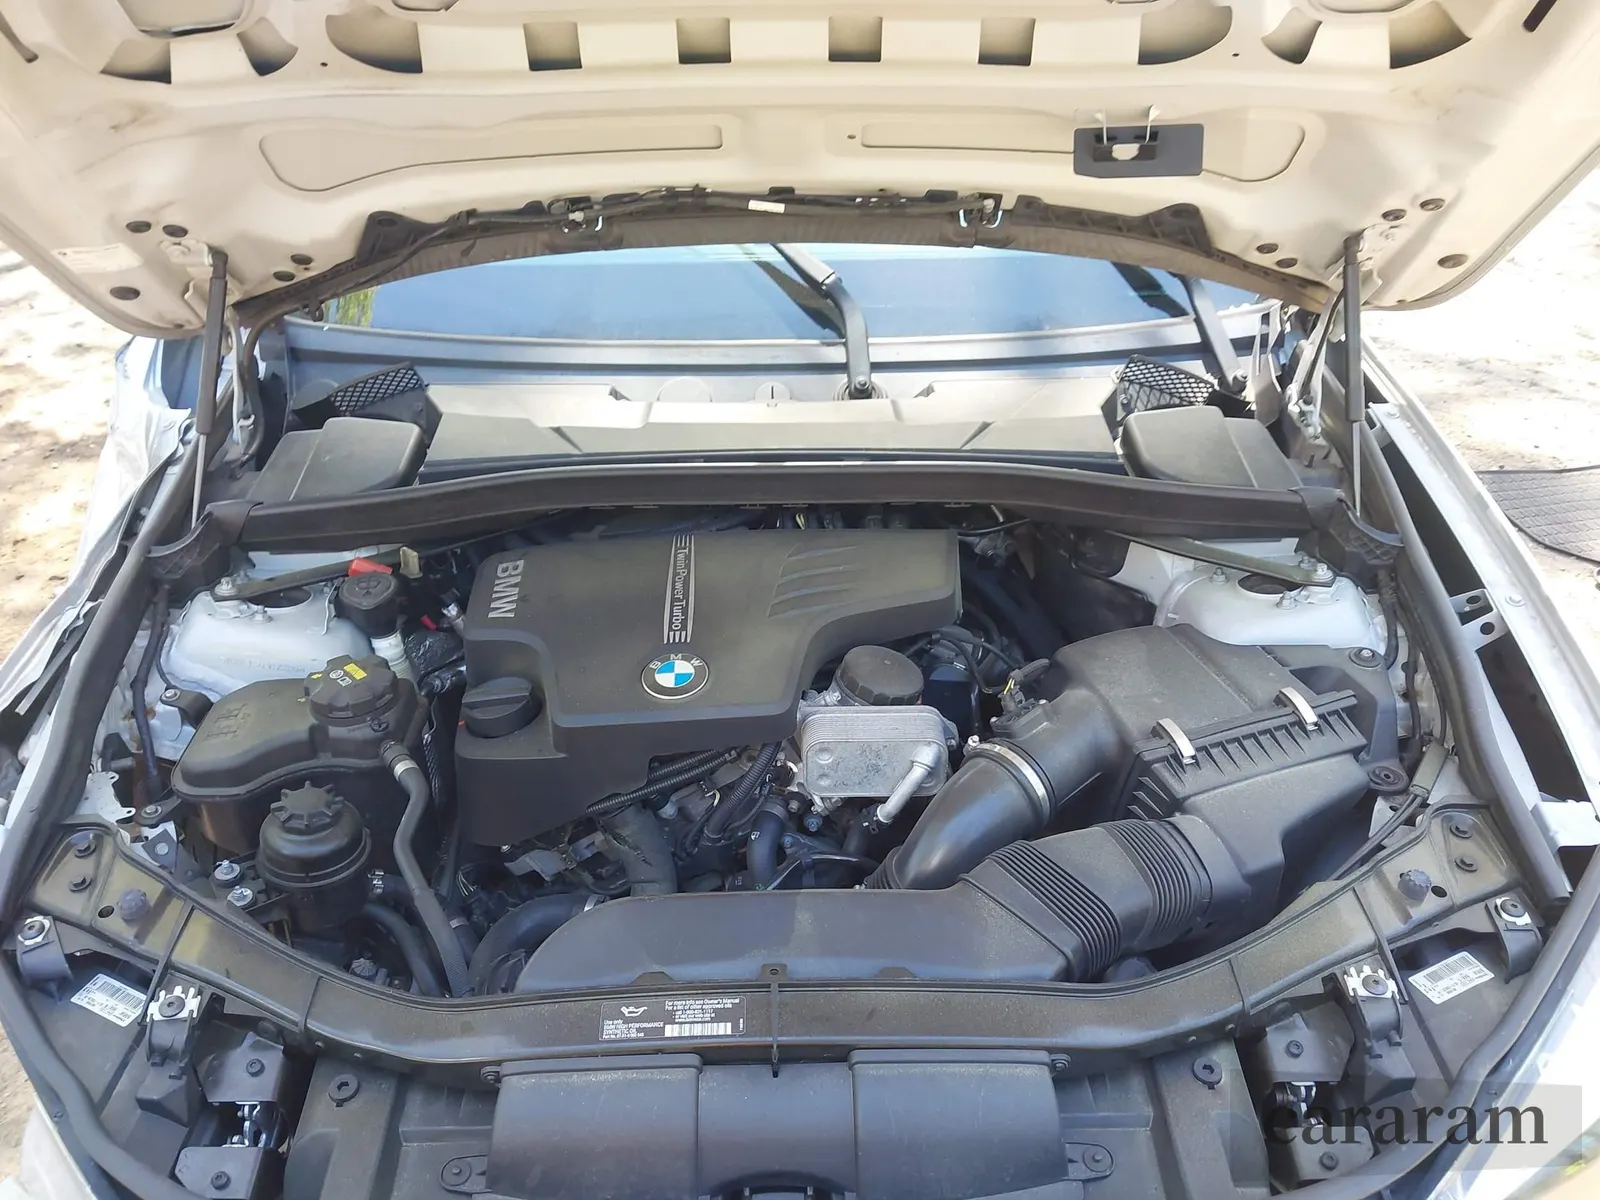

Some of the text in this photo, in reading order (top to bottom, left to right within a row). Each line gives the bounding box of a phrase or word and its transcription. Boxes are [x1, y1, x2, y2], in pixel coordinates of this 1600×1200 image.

[488, 560, 524, 618] BMW
[672, 547, 688, 630] TwinPower Turbo
[649, 653, 704, 669] BMW
